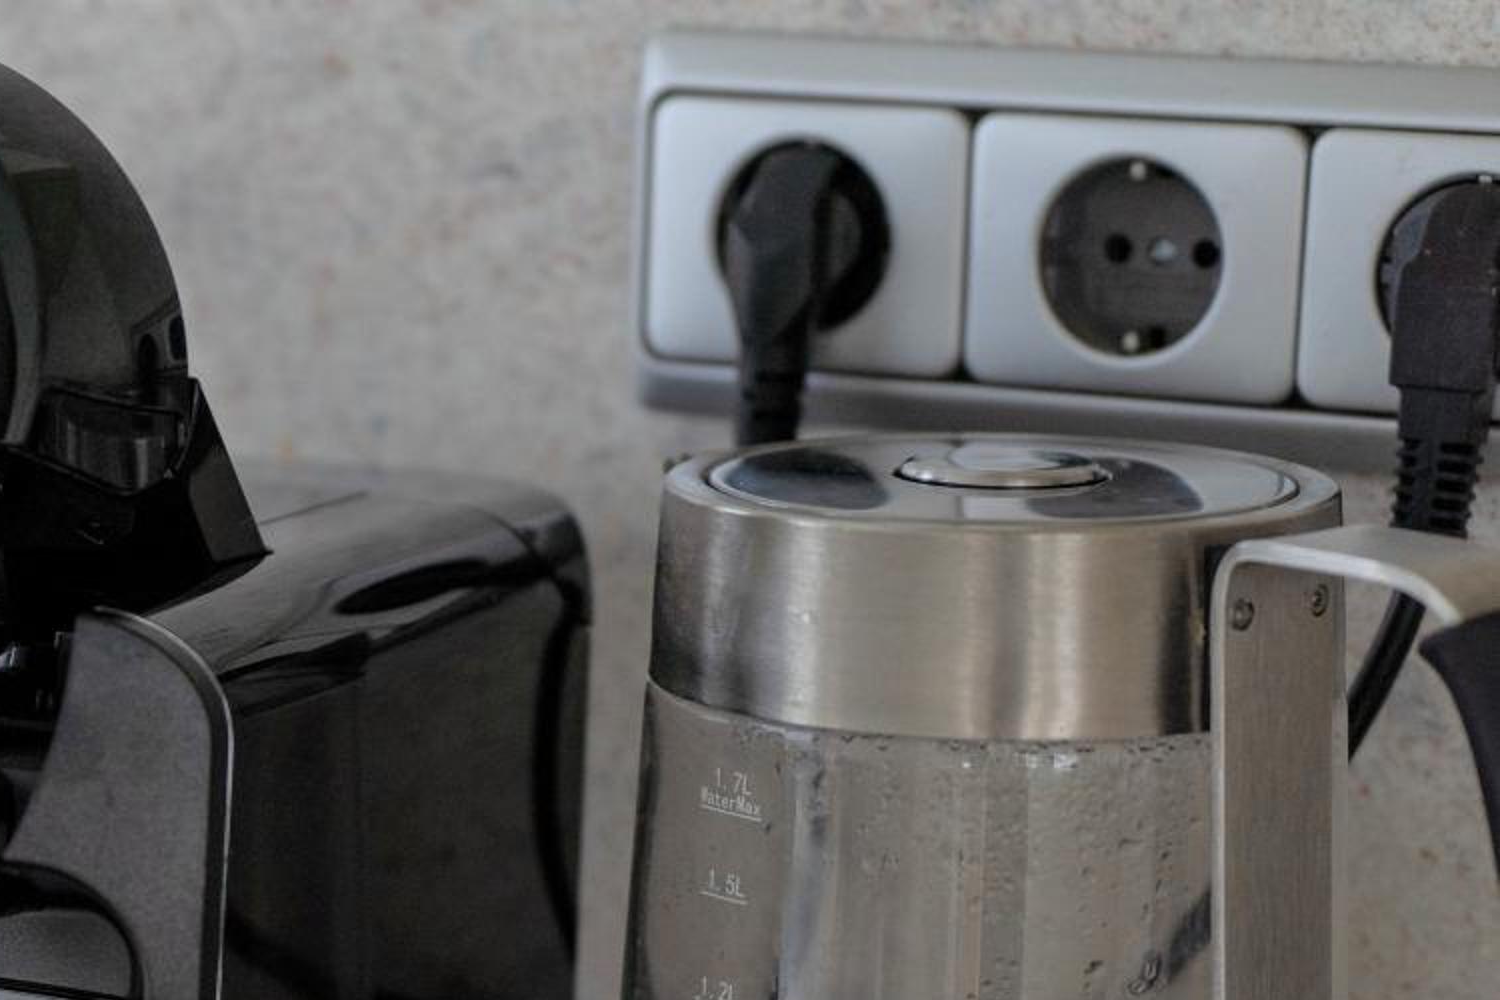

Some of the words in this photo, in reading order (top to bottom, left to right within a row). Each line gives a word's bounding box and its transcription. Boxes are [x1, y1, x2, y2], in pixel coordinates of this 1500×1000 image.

[715, 767, 752, 796] 1.7L
[700, 785, 762, 816] WaterMax
[708, 867, 747, 898] 1.5L
